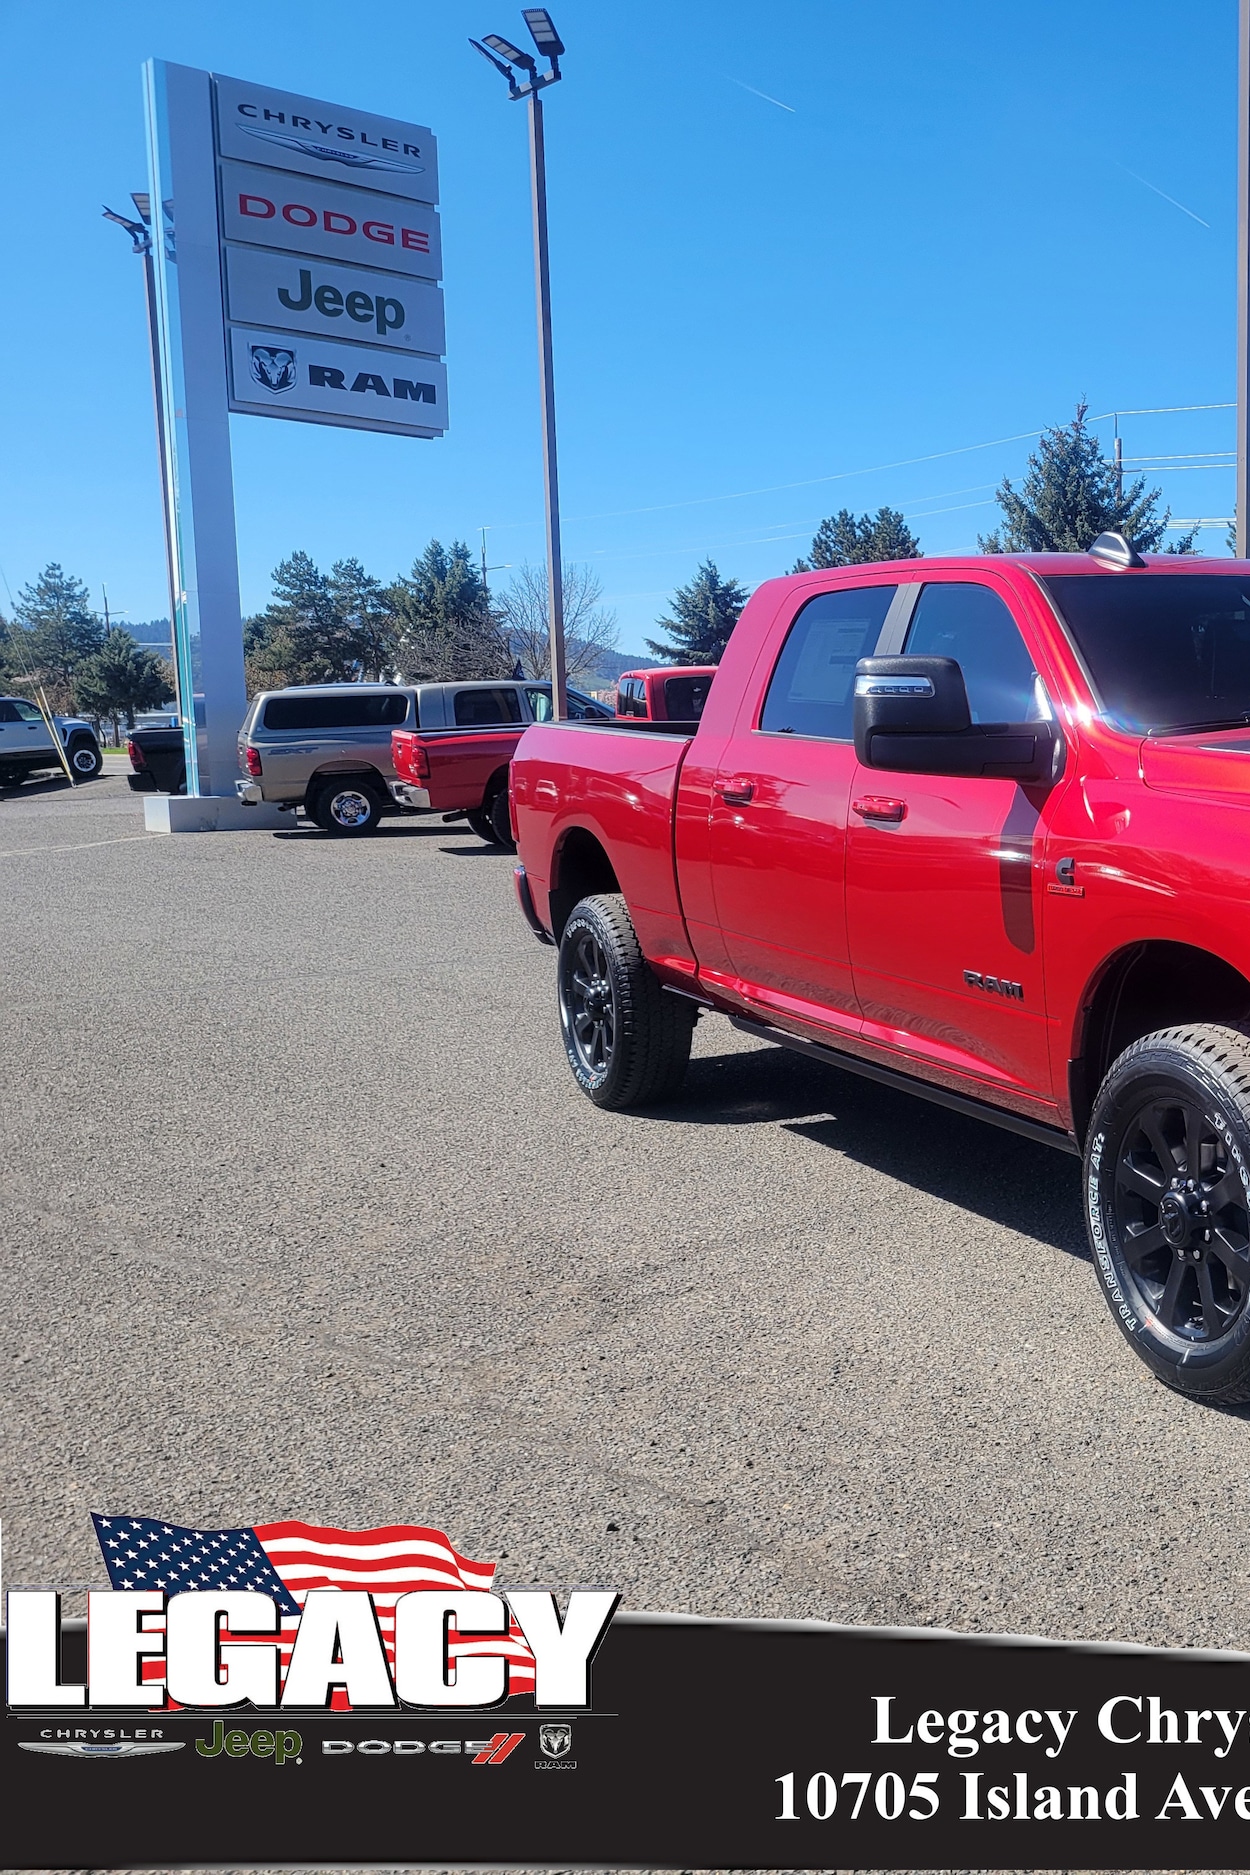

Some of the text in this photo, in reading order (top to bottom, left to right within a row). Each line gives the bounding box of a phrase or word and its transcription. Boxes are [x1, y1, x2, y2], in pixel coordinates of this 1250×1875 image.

[237, 103, 422, 159] CHRYSLER
[239, 193, 430, 254] DODGE
[277, 269, 406, 335] Jeep
[308, 364, 437, 405] RAM
[963, 969, 1024, 1002] RAM
[1089, 1175, 1138, 1332] TRANSFORCE
